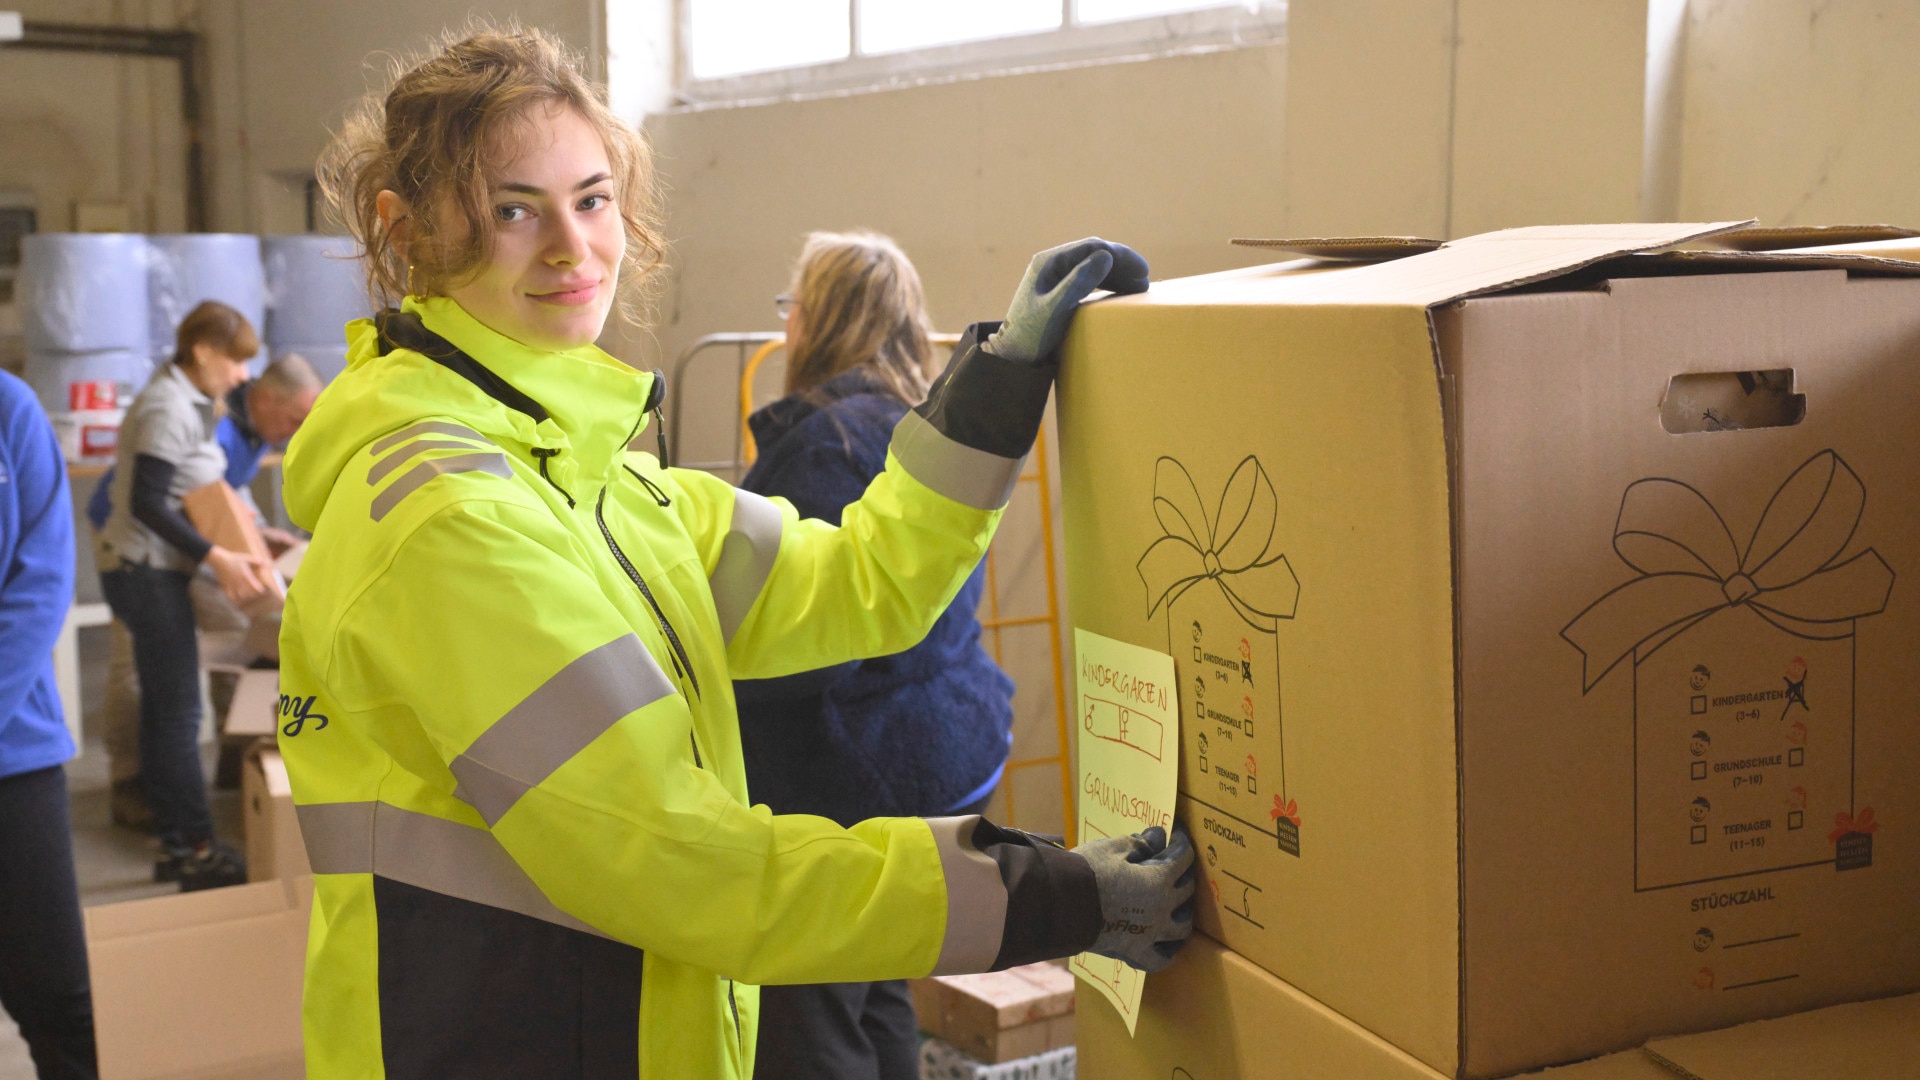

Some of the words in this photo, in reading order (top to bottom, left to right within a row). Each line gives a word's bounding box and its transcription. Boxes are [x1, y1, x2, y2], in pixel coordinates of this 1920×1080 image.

[1204, 652, 1240, 672] KINDERGARTEN
[1082, 654, 1168, 712] KINDERGARTEN
[1712, 690, 1784, 707] KINDERGARTEN
[1207, 708, 1242, 731] GRUNDSCHULE
[1713, 754, 1783, 773] GRUNDSCHULE
[1214, 765, 1240, 783] TEENAGER
[1203, 817, 1247, 848] STÜCKZAHL
[1723, 820, 1772, 835] TEENAGER
[1690, 887, 1777, 912] STÜCKZAHL
